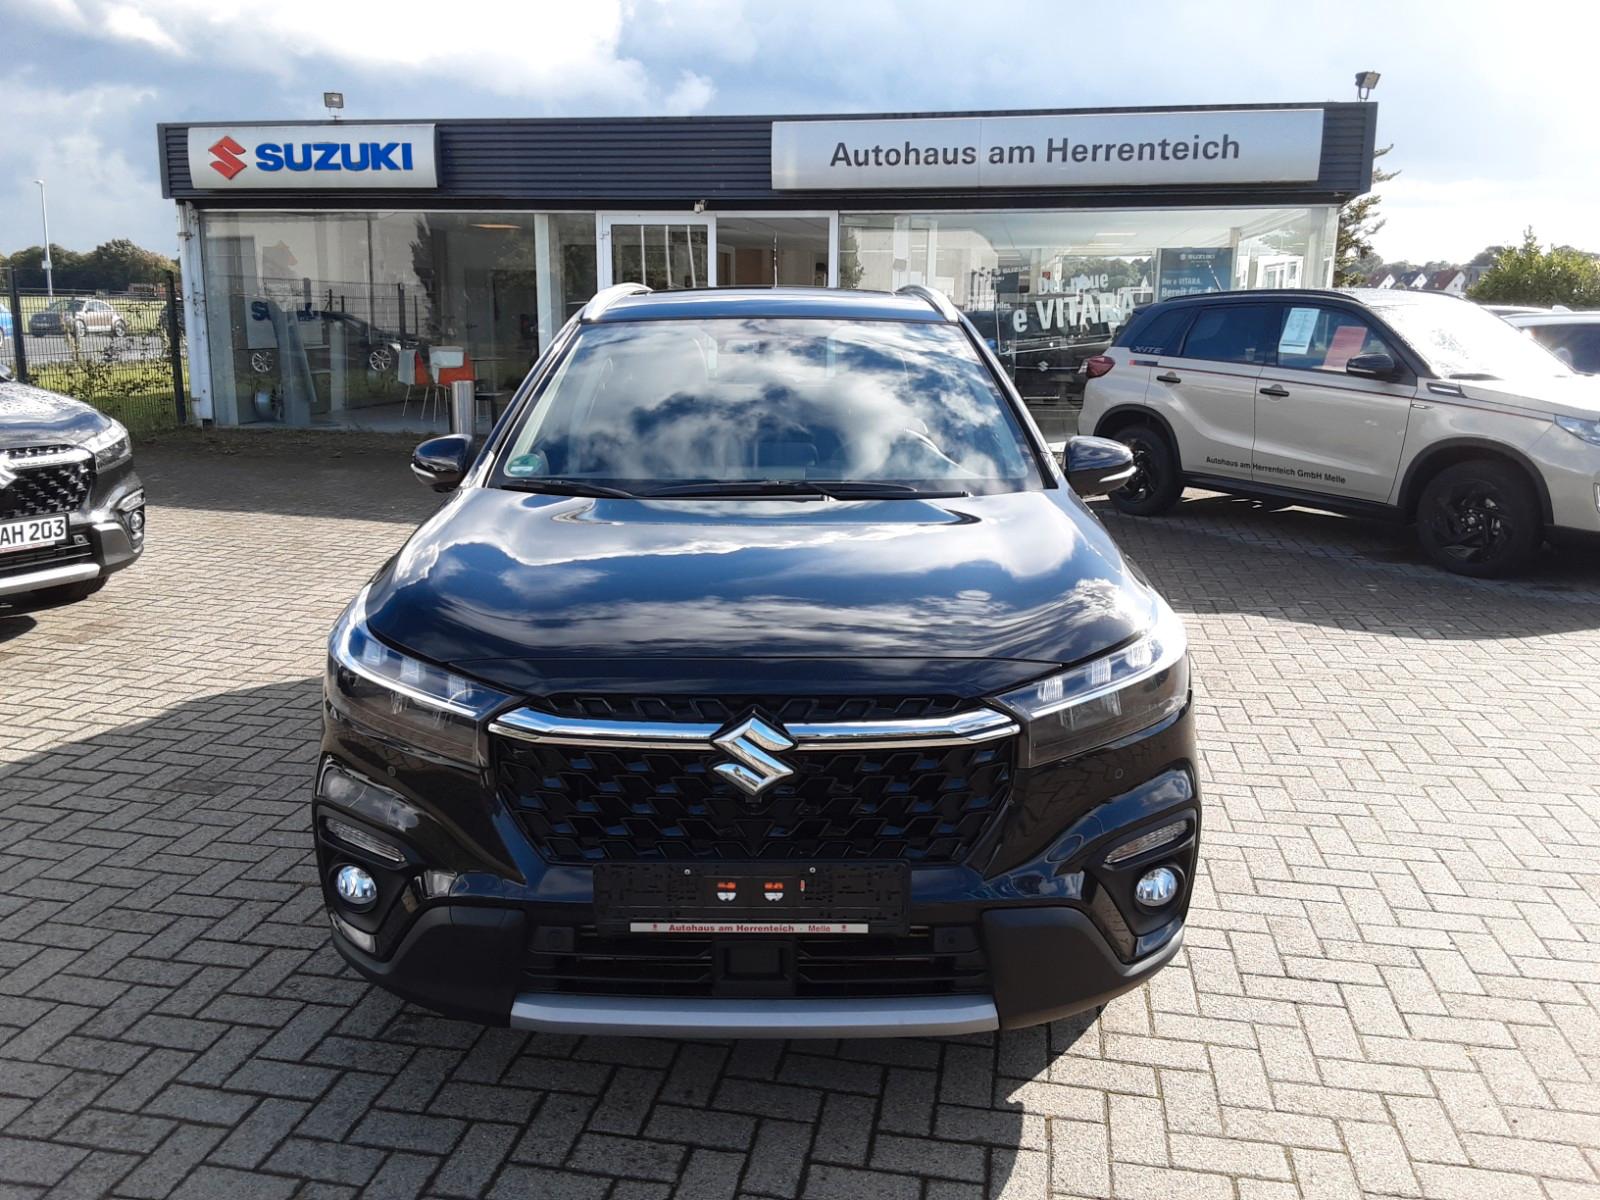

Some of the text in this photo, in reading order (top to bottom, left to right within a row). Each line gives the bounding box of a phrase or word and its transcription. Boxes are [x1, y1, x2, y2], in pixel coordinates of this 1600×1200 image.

[255, 142, 413, 172] SUZUKI
[829, 133, 1240, 167] Autohaus am Herrenteich
[1012, 309, 1028, 333] e
[1035, 292, 1136, 330] VITARA
[1206, 456, 1238, 467] Autohaus
[1252, 463, 1296, 477] Herrenteich
[1297, 469, 1323, 480] GmbH
[1324, 473, 1347, 484] Melle
[0, 519, 65, 546] AH 203
[669, 924, 716, 932] Autohaus
[736, 924, 795, 933] Herrenteich
[808, 925, 831, 933] Melle
